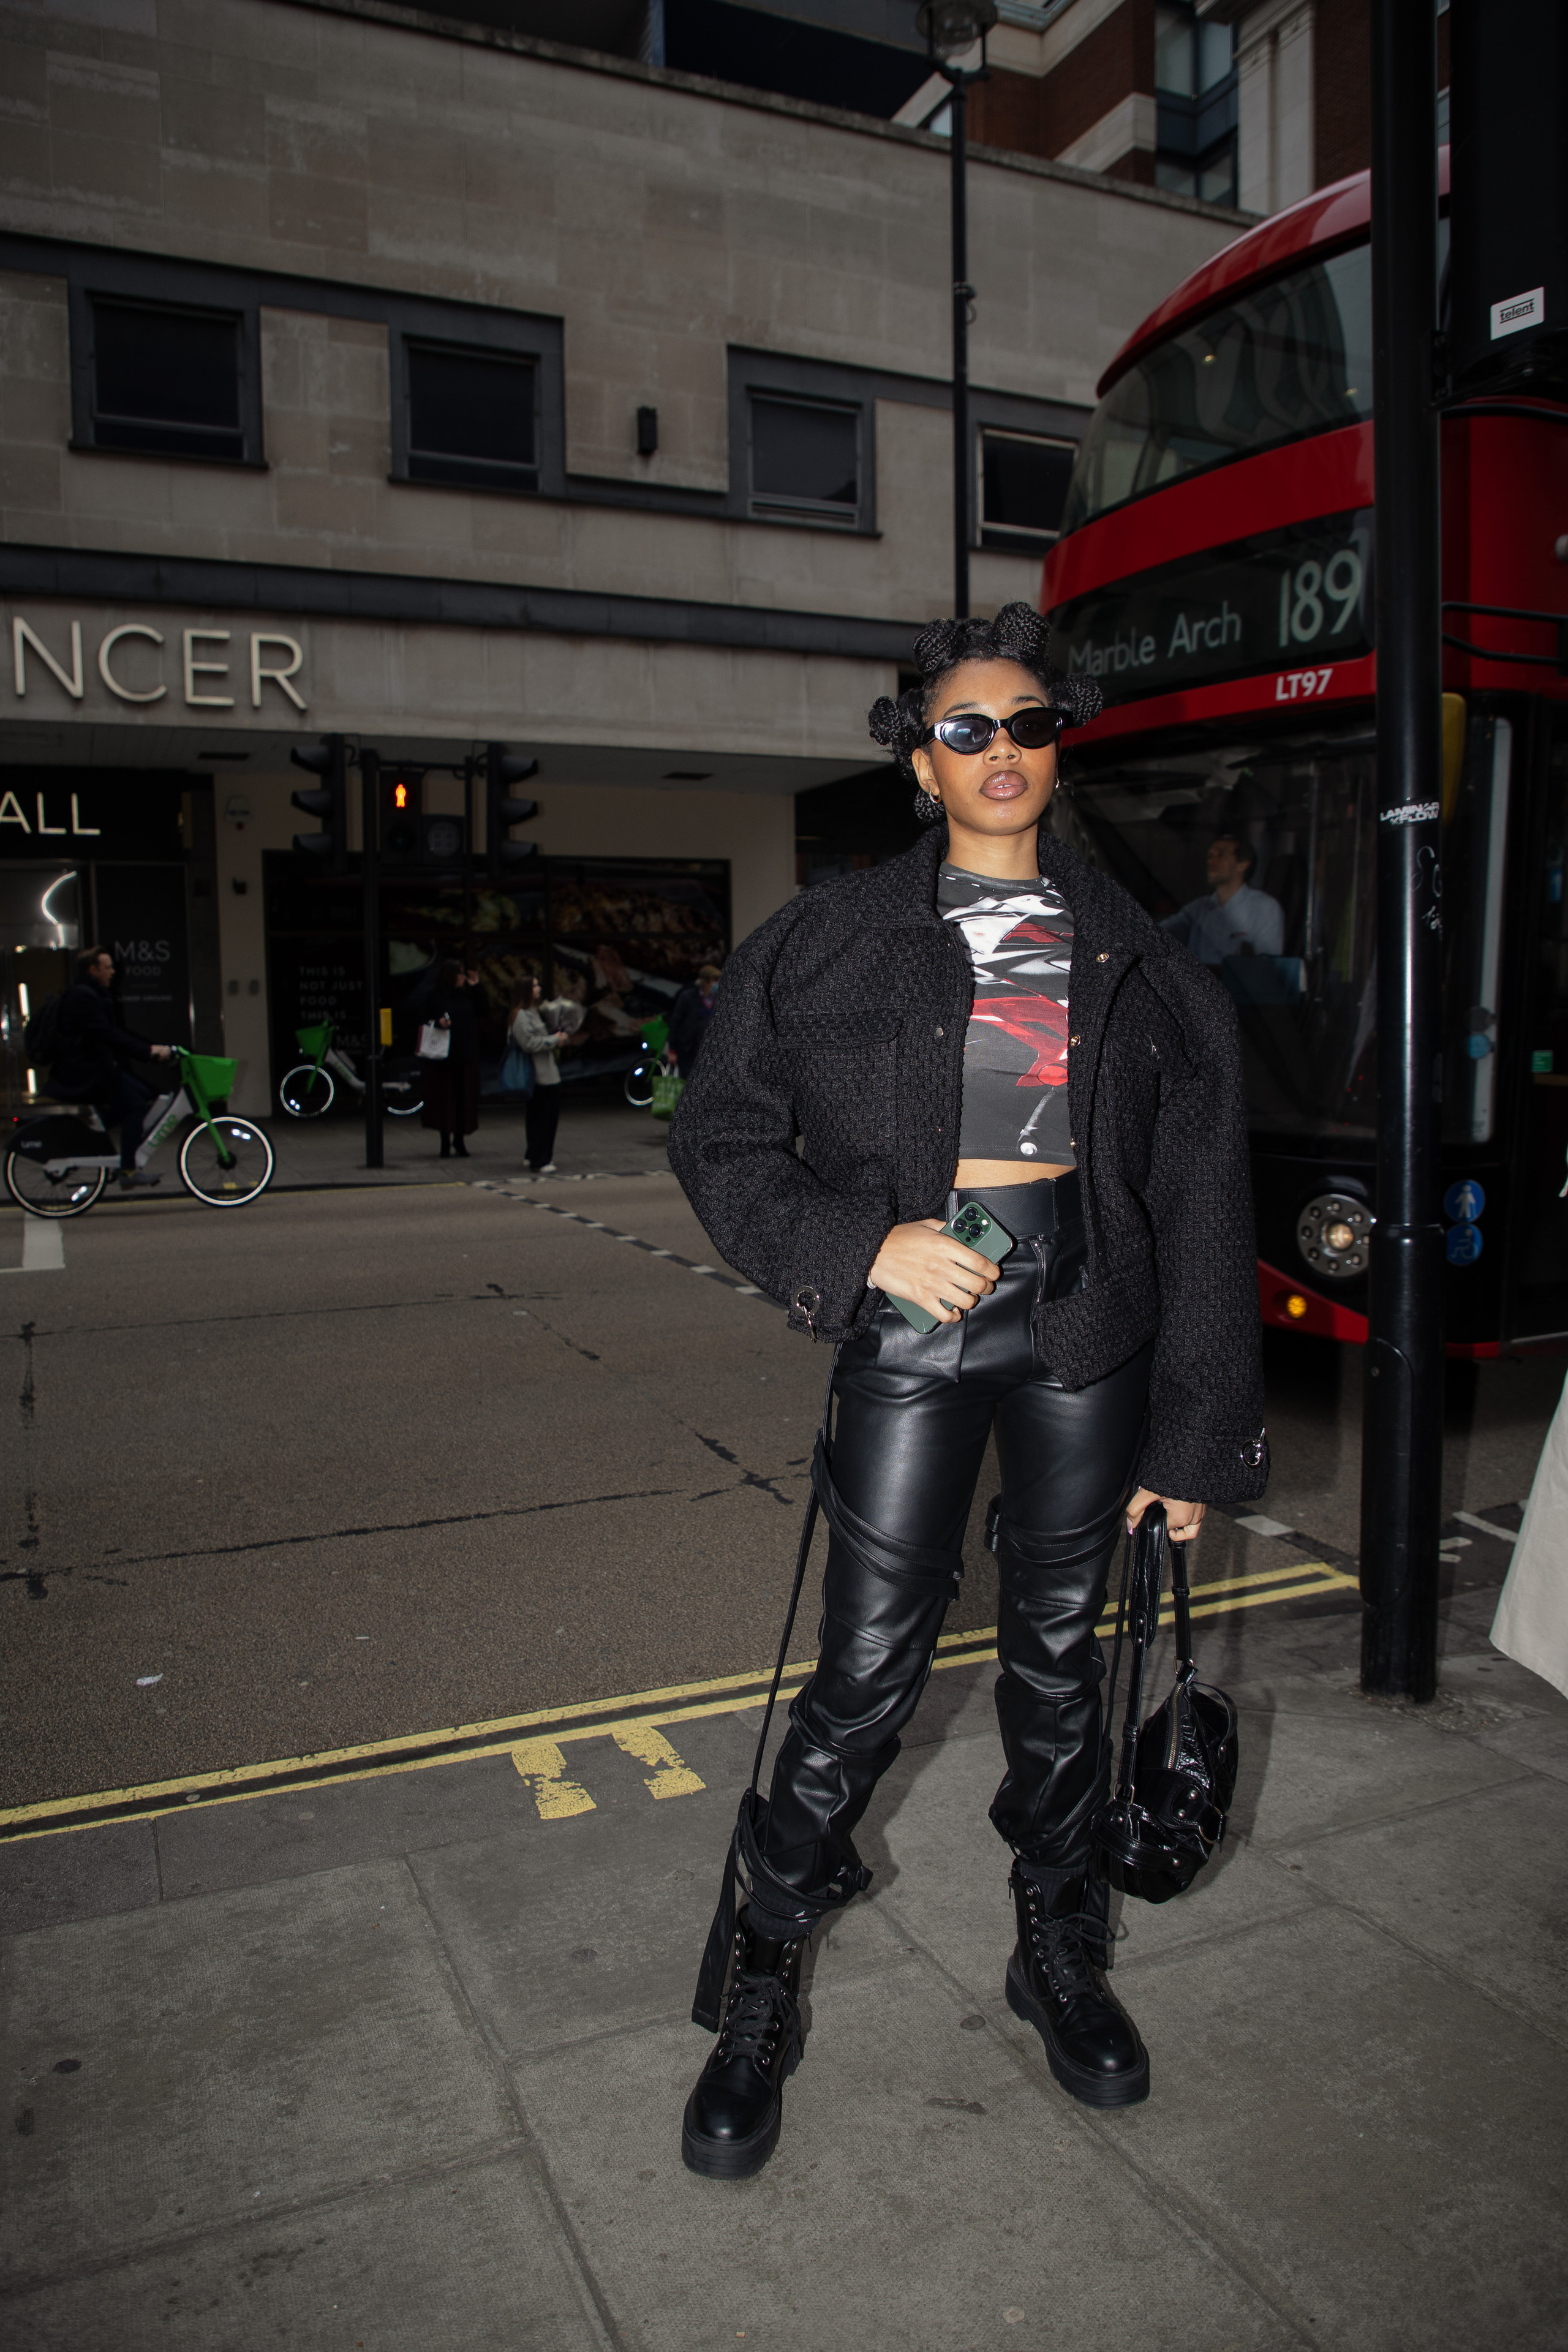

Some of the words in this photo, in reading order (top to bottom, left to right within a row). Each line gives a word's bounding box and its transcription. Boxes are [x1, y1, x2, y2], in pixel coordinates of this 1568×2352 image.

[1499, 301, 1534, 321] telent
[1278, 549, 1363, 648] 189
[1068, 626, 1156, 678] Marble
[1166, 600, 1242, 659] Arch
[12, 615, 307, 710] NCER
[1275, 668, 1334, 703] LT97
[0, 790, 102, 836] ALL
[113, 939, 172, 962] M&S
[126, 965, 162, 977] FOOD
[299, 966, 328, 976] THIS
[333, 966, 346, 976] IS
[299, 981, 325, 991] NOT
[330, 980, 363, 991] JUST
[300, 995, 337, 1006] FOOD
